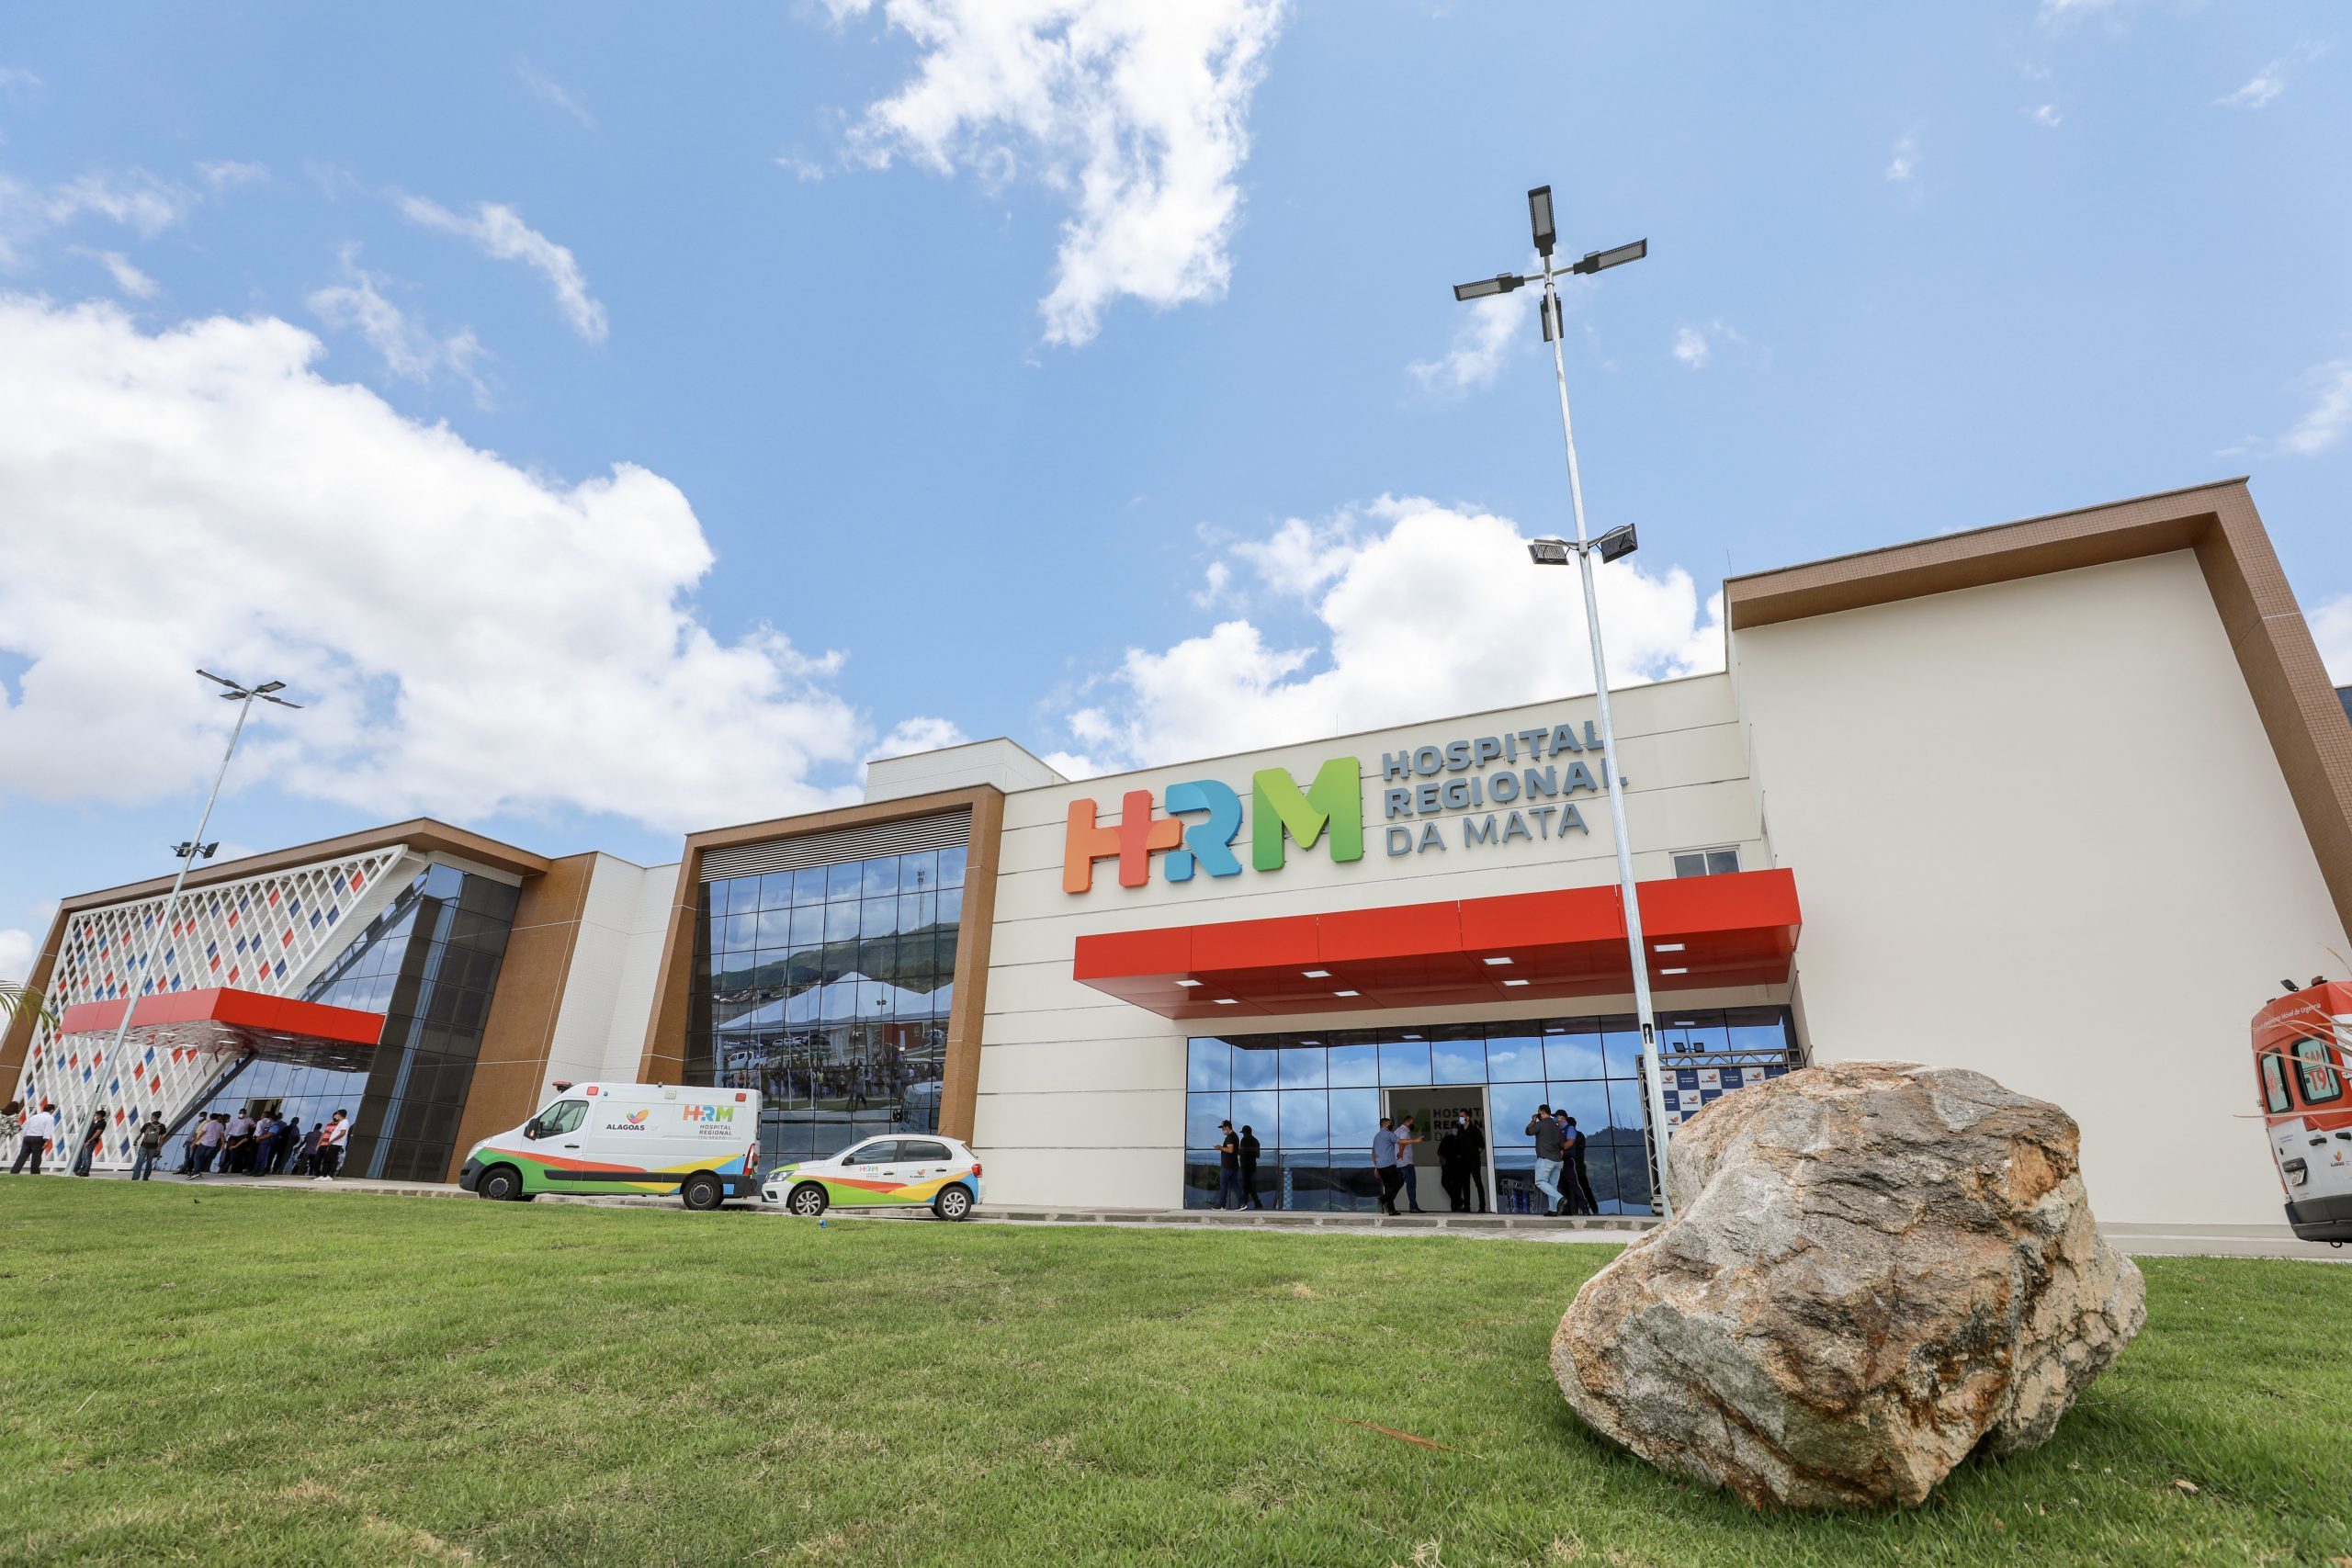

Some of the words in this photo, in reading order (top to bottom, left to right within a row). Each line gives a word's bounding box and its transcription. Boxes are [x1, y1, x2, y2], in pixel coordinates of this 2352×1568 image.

[1383, 720, 1605, 781] HOSPITAL
[1062, 756, 1363, 894] HRM
[1385, 822, 1447, 856] DA
[1463, 803, 1589, 848] MATA
[2308, 1068, 2332, 1090] 19
[683, 1105, 734, 1122] HRM
